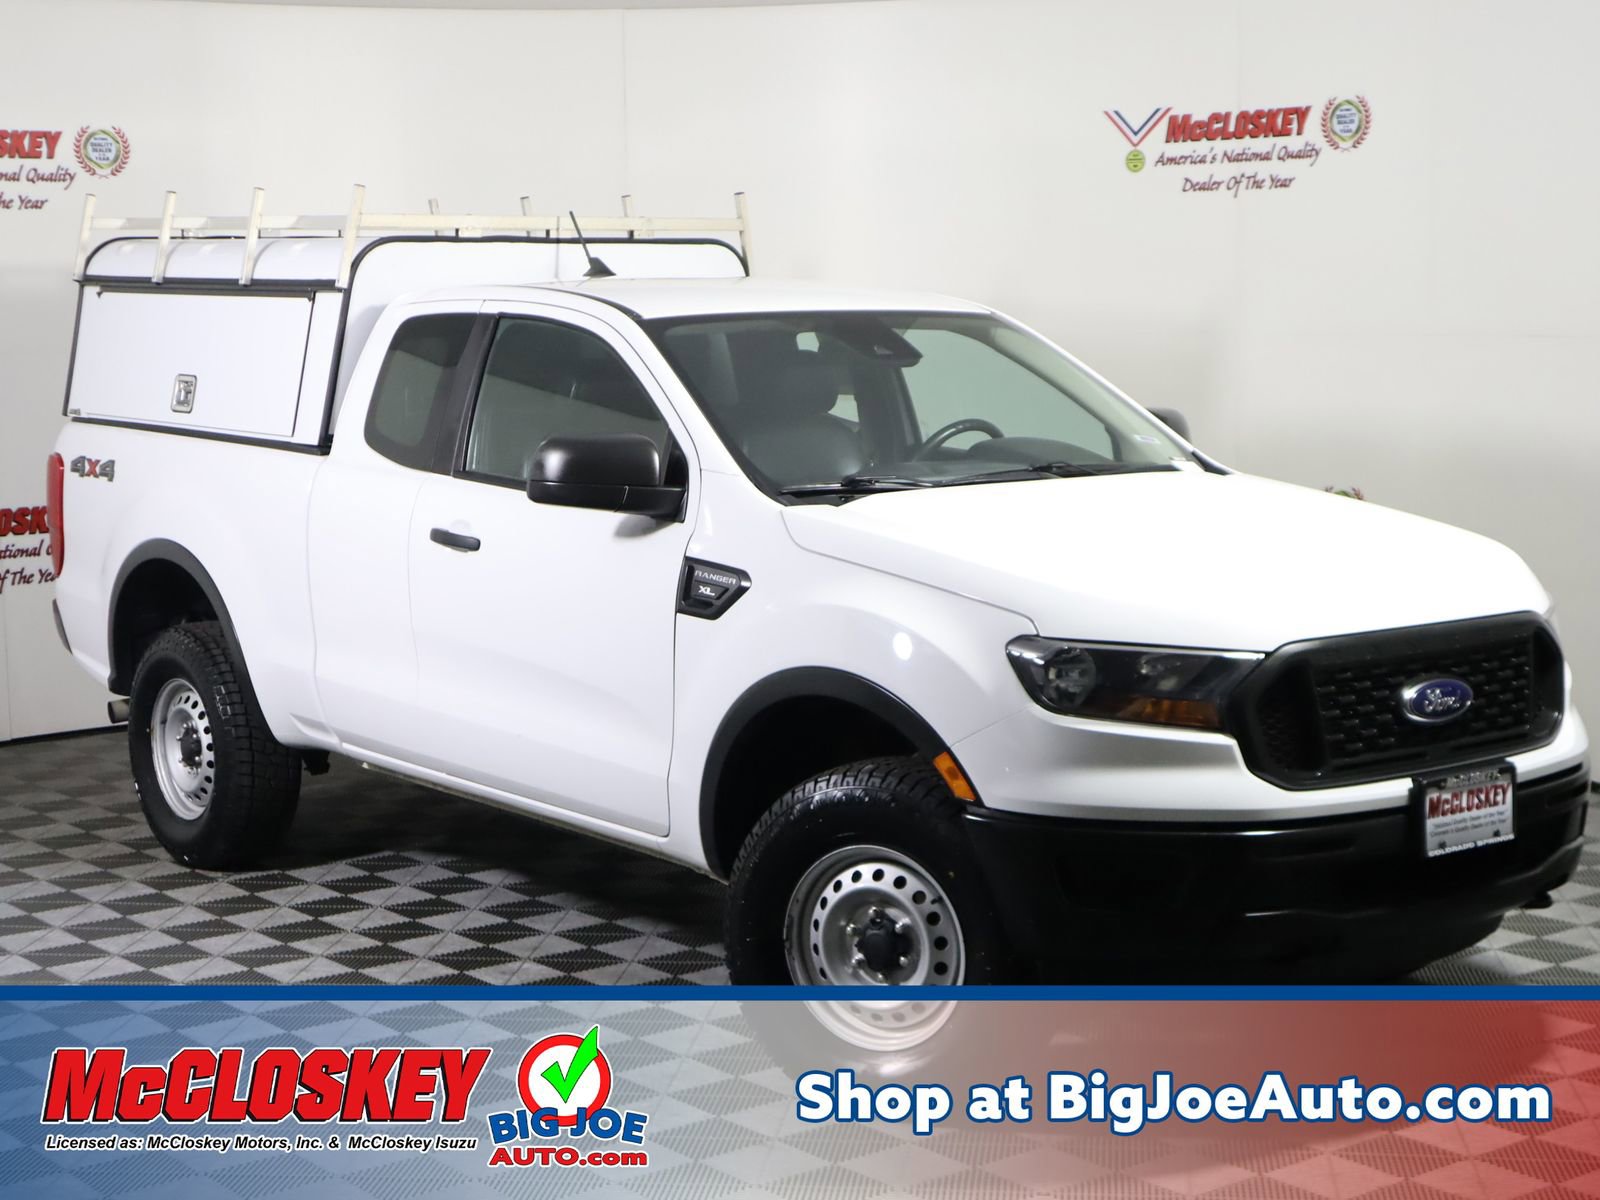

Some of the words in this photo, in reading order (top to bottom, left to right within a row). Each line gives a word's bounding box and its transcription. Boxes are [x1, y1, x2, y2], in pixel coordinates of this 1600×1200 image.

[1165, 105, 1312, 144] McCLOSKEY
[1154, 146, 1217, 167] America's
[1220, 143, 1277, 164] National
[1277, 141, 1322, 168] Quality
[25, 164, 77, 191] Quality
[1182, 174, 1224, 193] Dealer
[1226, 173, 1245, 199] Of
[1245, 172, 1266, 191] The
[1268, 174, 1295, 191] Year
[18, 195, 49, 211] Year
[11, 567, 35, 586] The
[694, 570, 737, 585] RANGER
[698, 585, 715, 596] XL
[1423, 686, 1460, 713] Ford
[1428, 842, 1475, 857] COLORADO
